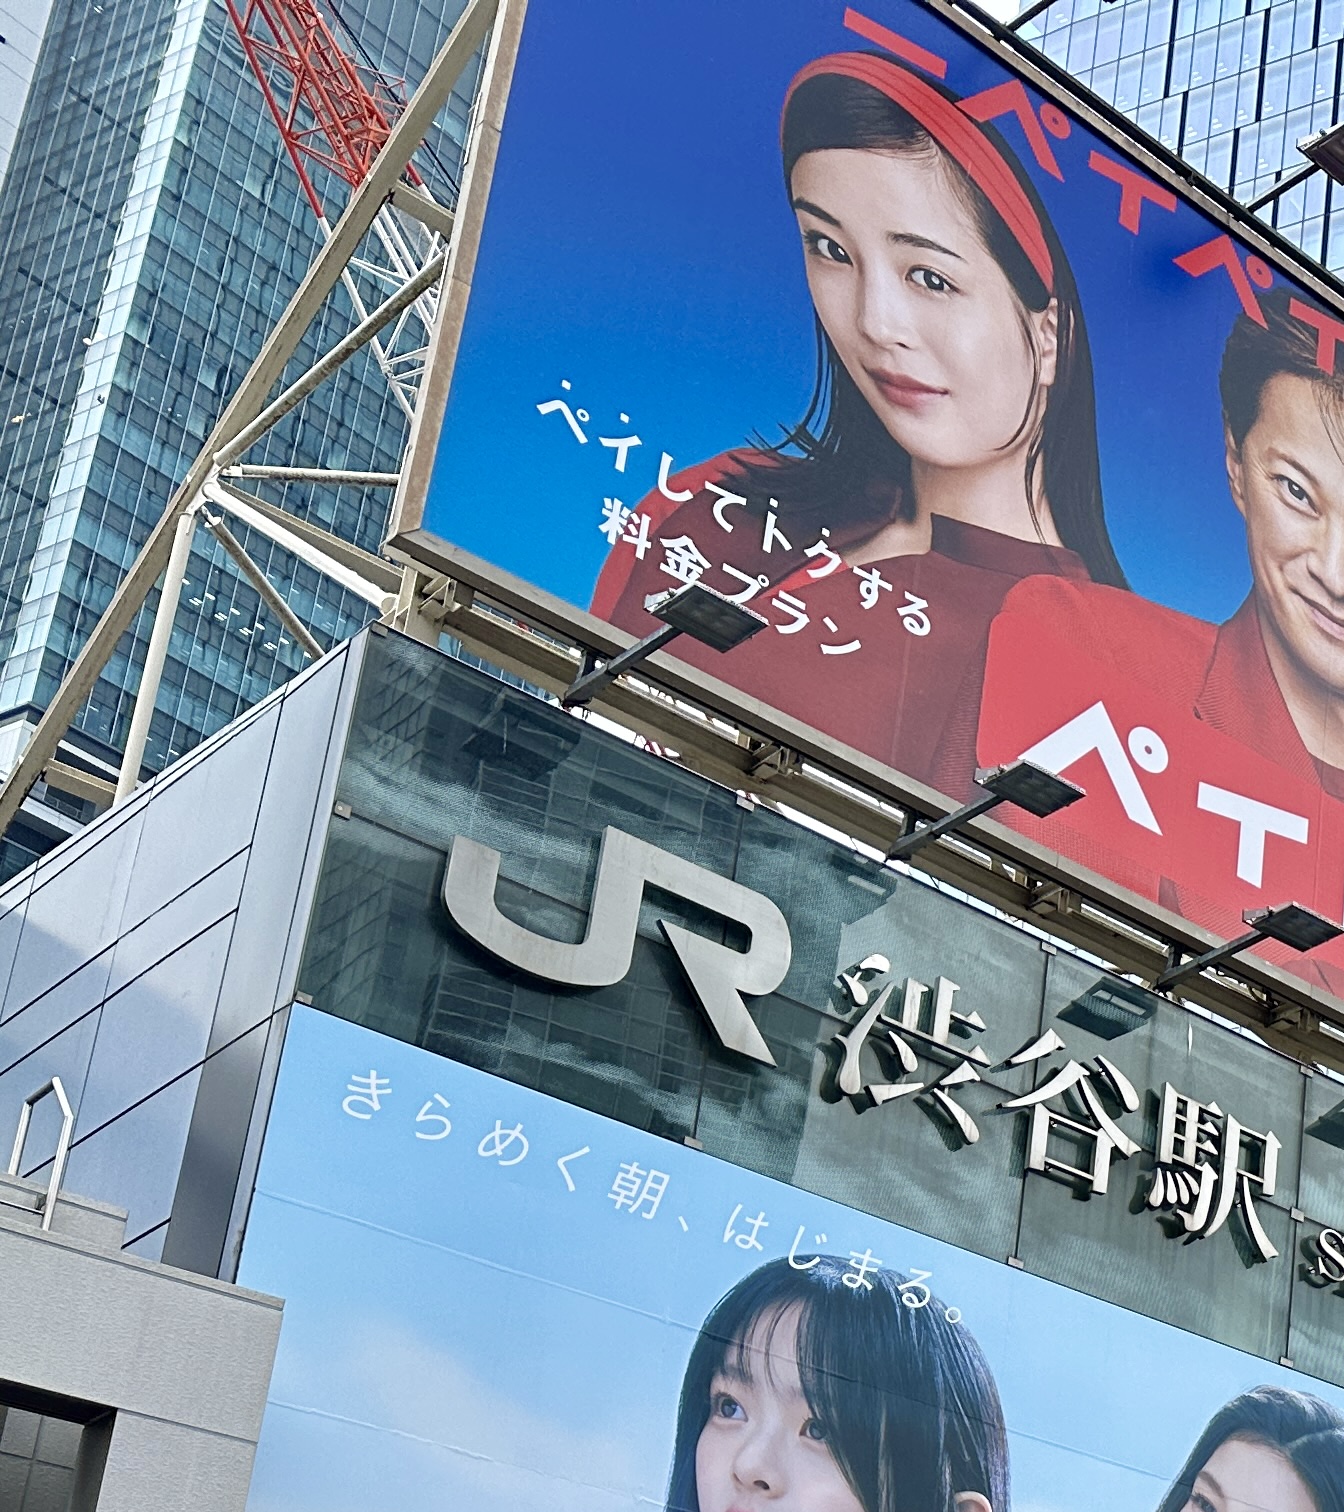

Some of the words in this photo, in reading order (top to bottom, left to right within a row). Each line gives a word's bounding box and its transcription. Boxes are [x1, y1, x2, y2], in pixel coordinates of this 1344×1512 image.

[537, 380, 931, 637] ペイしてトクする
[598, 496, 862, 655] 料金プラン
[441, 825, 791, 1069] JR
[828, 952, 1280, 1264] 渋谷駅
[340, 1069, 963, 1325] きらめく朝、はじまる。
